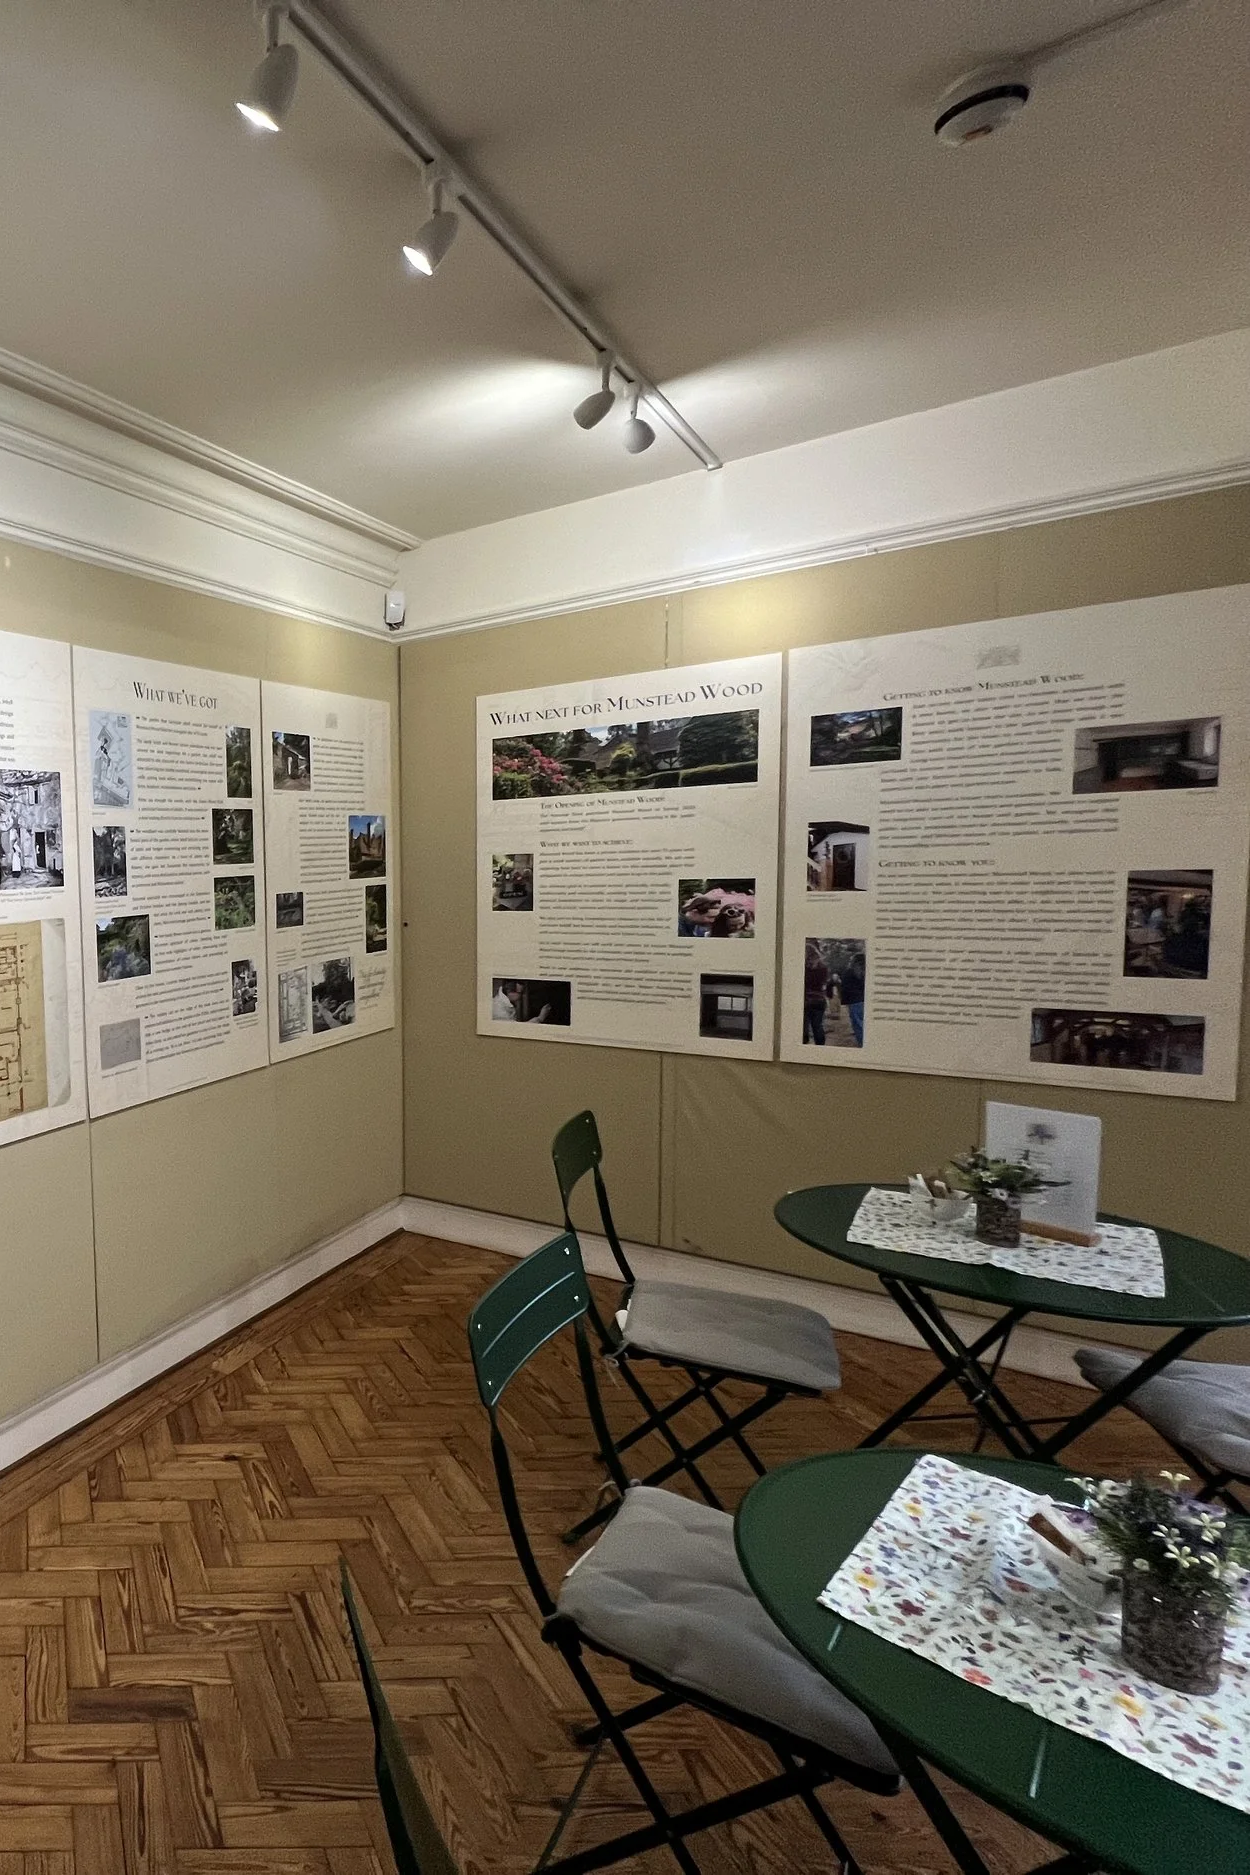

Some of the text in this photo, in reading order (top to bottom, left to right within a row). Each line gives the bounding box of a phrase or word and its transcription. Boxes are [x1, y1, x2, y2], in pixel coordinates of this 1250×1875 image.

[133, 681, 217, 709] WHAT WE'VE GOT
[489, 682, 763, 727] WHAT NEXT FOR MUNSTEAD WOOD
